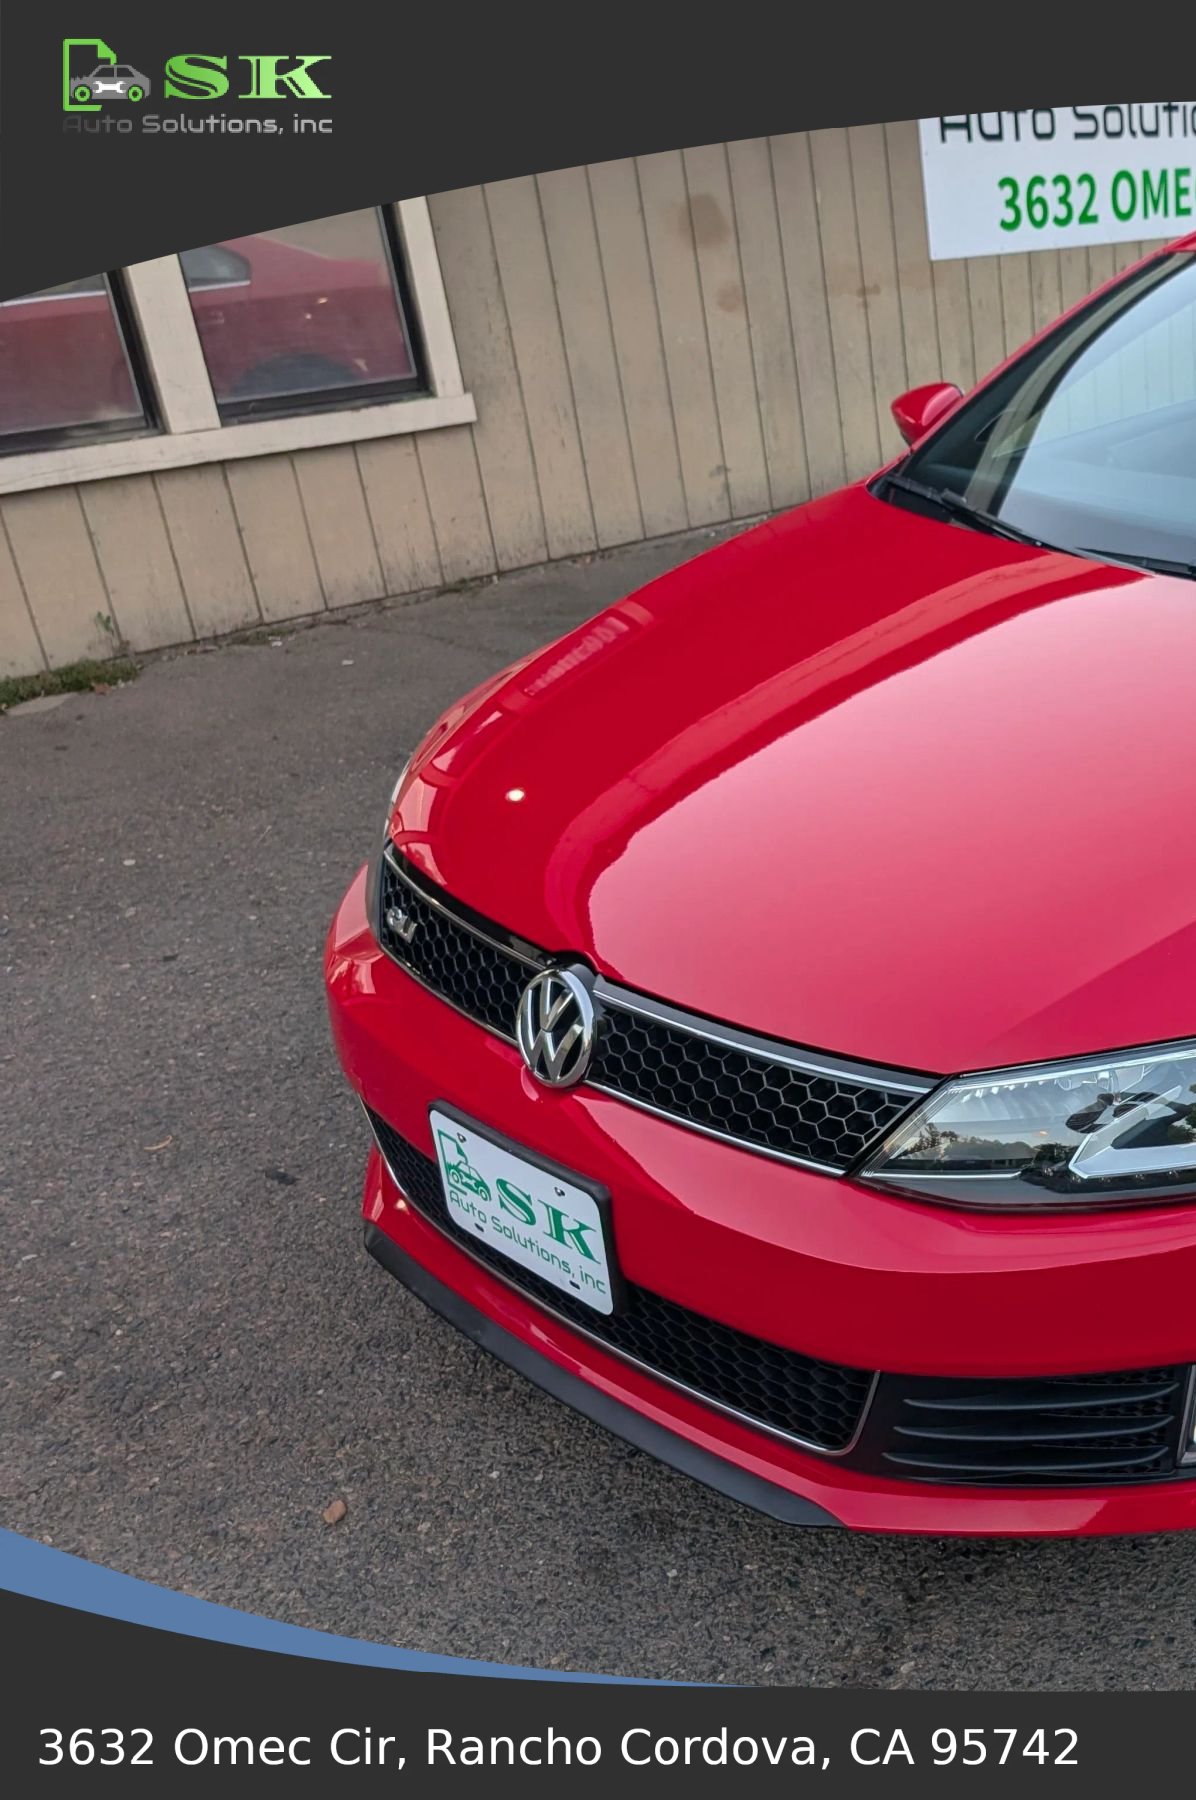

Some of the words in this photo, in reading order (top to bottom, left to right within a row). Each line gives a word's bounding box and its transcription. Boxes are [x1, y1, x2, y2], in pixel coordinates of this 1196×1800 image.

[997, 172, 1099, 232] 3632
[449, 1187, 487, 1224] Auto
[491, 1216, 575, 1278] Solutions,
[580, 1266, 607, 1295] inc
[496, 1178, 601, 1265] SK
